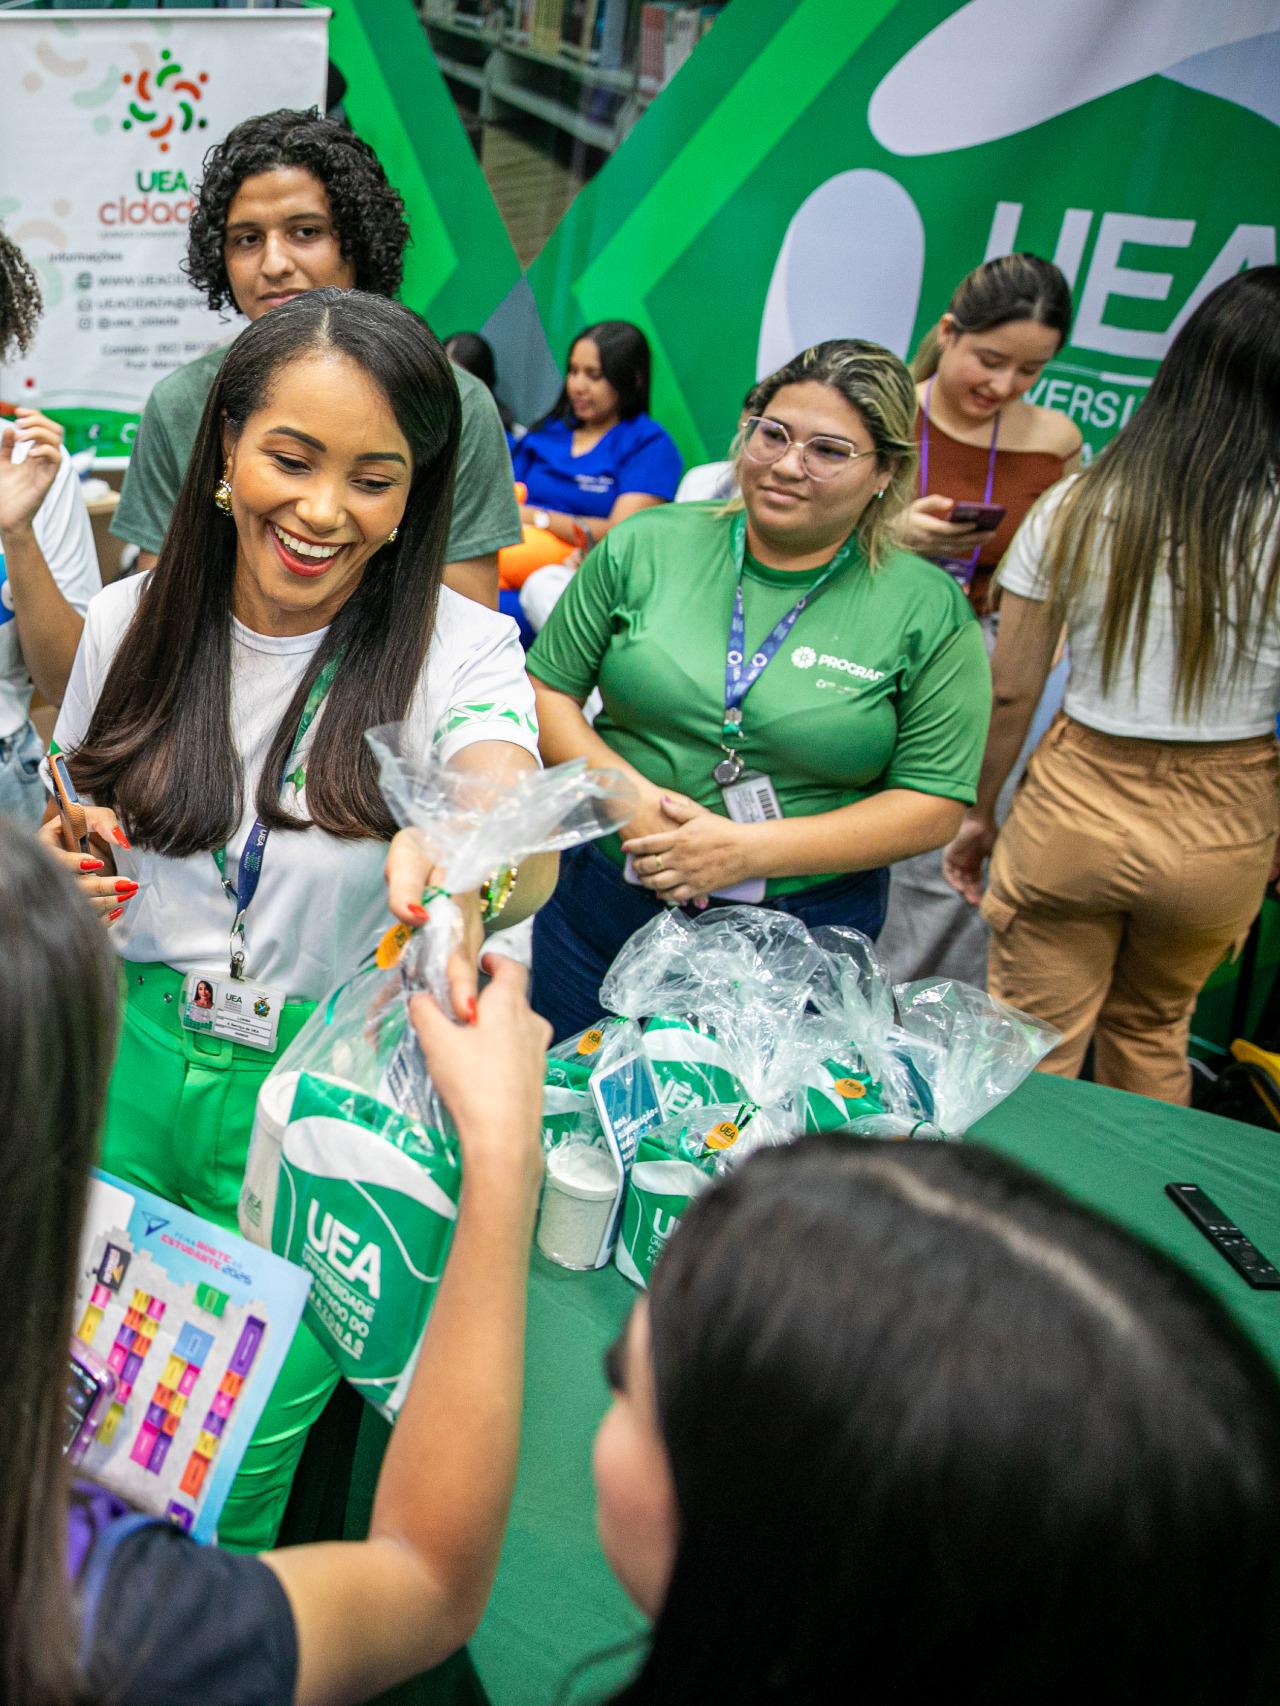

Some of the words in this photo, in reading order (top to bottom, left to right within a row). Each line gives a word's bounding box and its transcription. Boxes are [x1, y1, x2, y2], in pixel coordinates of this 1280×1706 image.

[136, 169, 188, 193] UEA
[98, 197, 197, 226] cidad
[256, 829, 268, 847] UEA
[225, 993, 243, 1005] UEA
[719, 1122, 737, 1141] UEA
[307, 1198, 382, 1300] UEA
[308, 1289, 365, 1355] MAZONAS
[348, 1315, 370, 1338] DO
